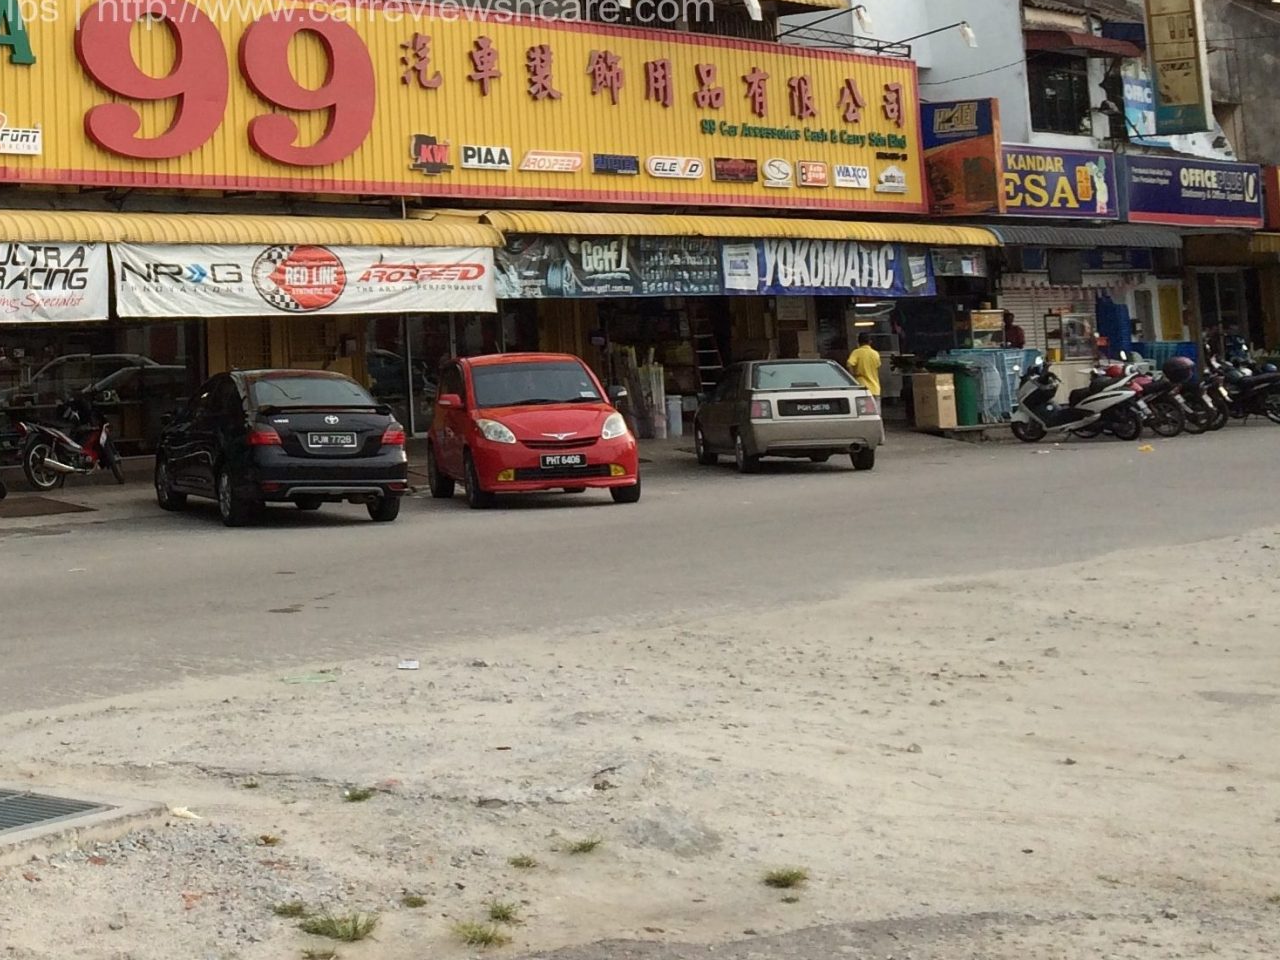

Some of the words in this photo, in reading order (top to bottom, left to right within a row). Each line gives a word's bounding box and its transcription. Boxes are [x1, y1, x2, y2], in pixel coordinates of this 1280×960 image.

[420, 144, 450, 164] KW
[463, 146, 511, 166] PIAA
[1006, 154, 1065, 173] KANDAR
[835, 166, 868, 186] WAXCO
[764, 242, 895, 289] YOKOMATIC
[285, 267, 308, 286] RED
[313, 266, 338, 285] LINE
[21, 290, 84, 314] Specialist
[546, 456, 560, 465] PHT
